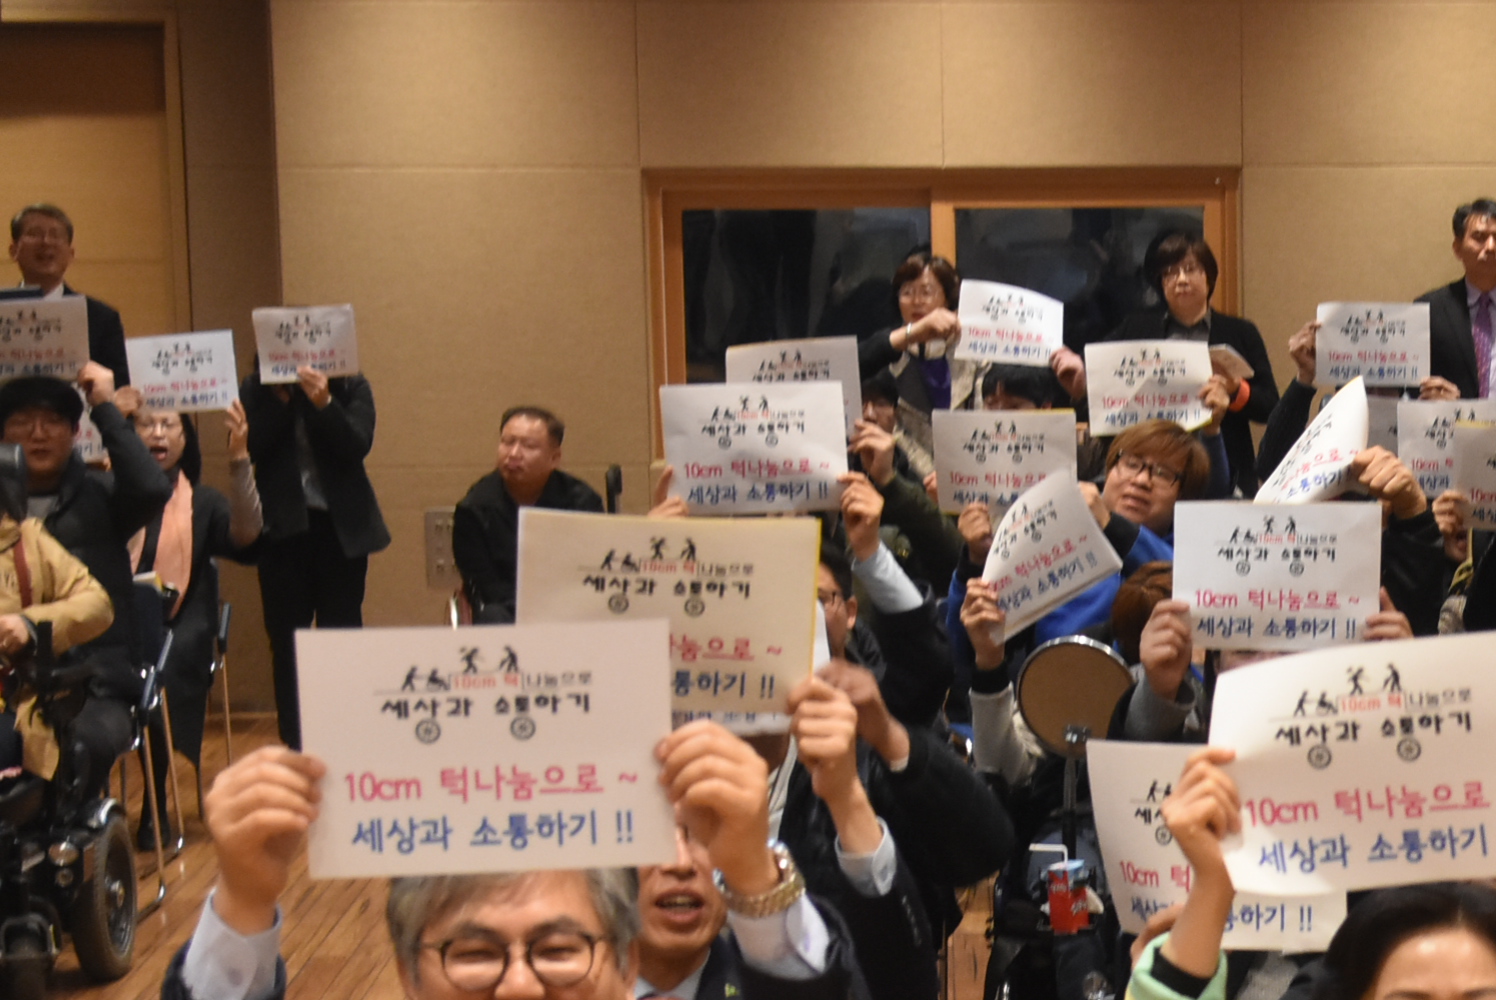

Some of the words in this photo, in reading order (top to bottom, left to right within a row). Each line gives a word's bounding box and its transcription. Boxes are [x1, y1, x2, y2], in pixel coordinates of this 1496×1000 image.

[684, 464, 722, 480] 10cm
[731, 459, 813, 478] 턱나눔으로
[688, 484, 738, 504] 세상과
[746, 481, 810, 501] 소통하기
[1195, 591, 1239, 608] 10cm
[1248, 591, 1341, 611] 턱나눔으로
[1198, 617, 1255, 639] 세상과
[1263, 619, 1335, 639] 소통하기
[670, 634, 757, 661] 눔으로
[670, 671, 747, 700] 통하기
[345, 774, 421, 801] 10cm
[440, 764, 604, 802] 턱나눔으로
[1245, 798, 1319, 827] 10cm
[1334, 780, 1491, 822] 턱나눔으로
[353, 816, 452, 854] 세상과
[470, 810, 597, 850] 소통하기
[1257, 835, 1353, 872] 세상과
[1367, 823, 1488, 866] 소통하기
[1119, 861, 1160, 889] 10cm
[1224, 903, 1285, 932] 하기
